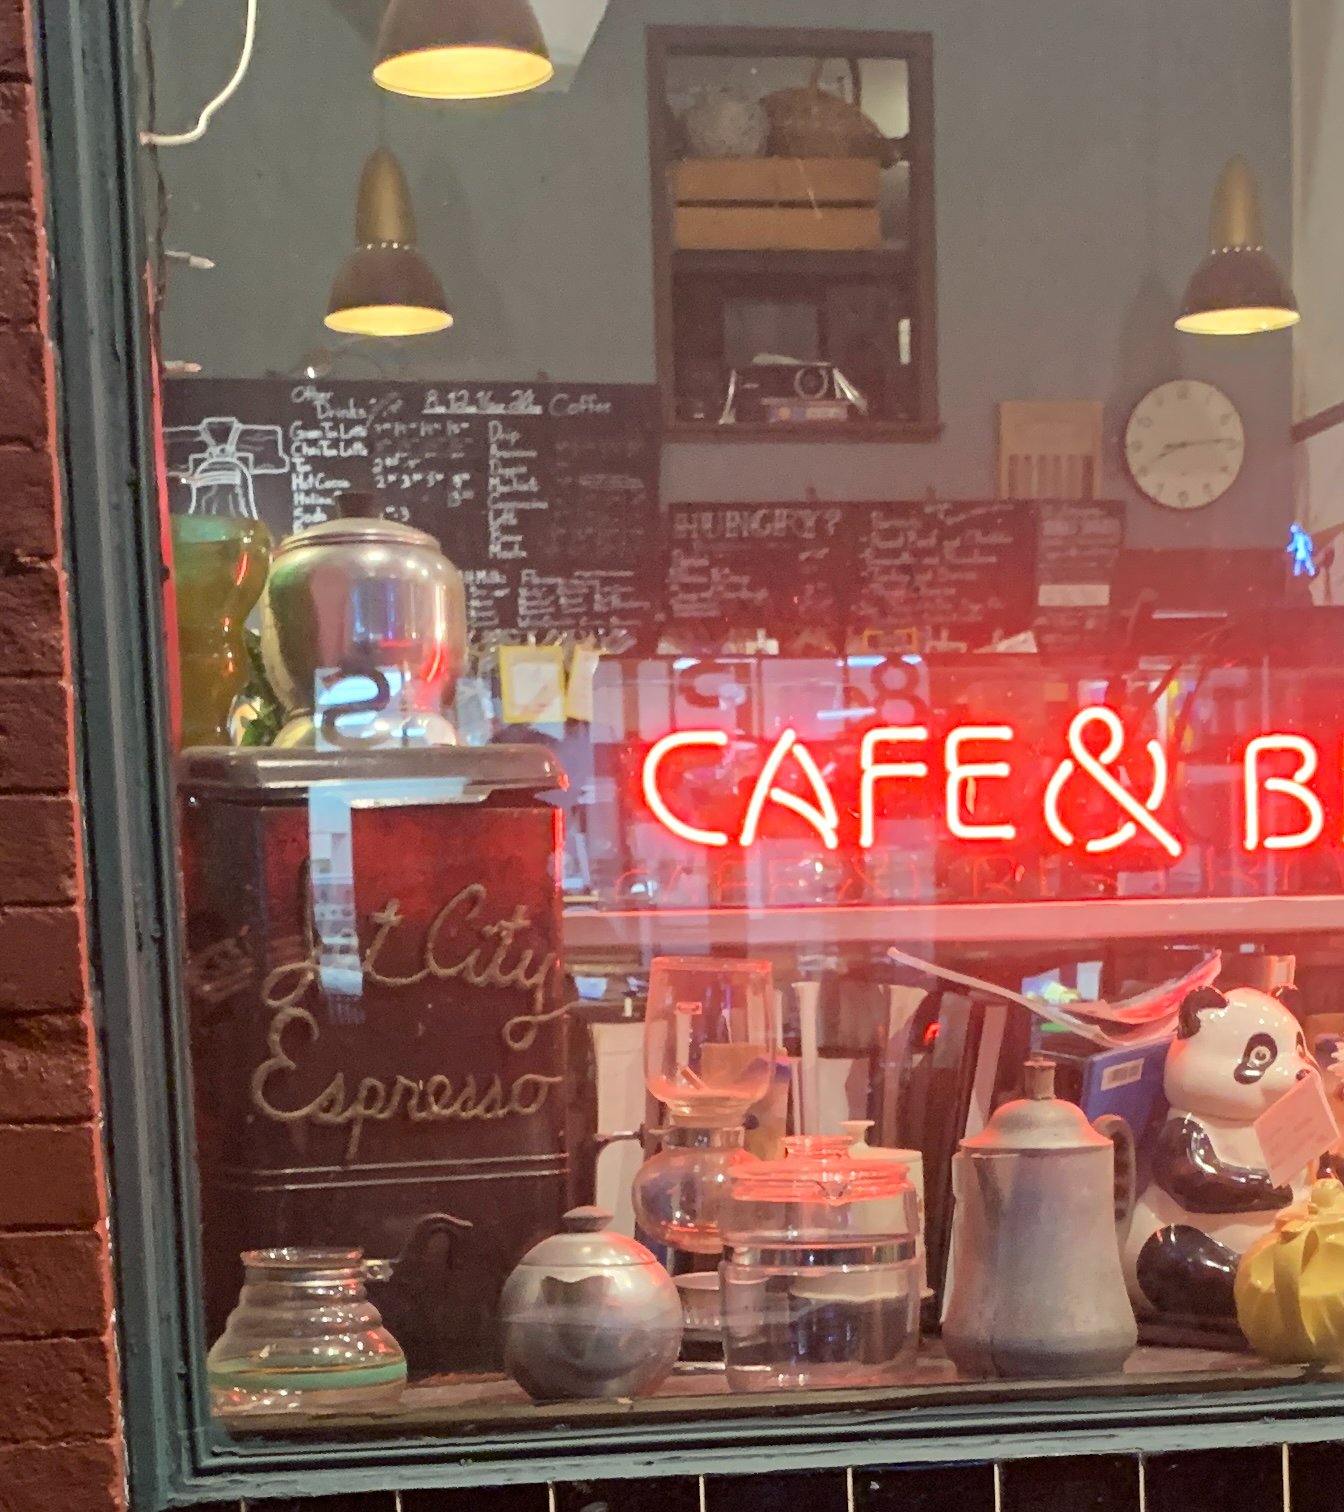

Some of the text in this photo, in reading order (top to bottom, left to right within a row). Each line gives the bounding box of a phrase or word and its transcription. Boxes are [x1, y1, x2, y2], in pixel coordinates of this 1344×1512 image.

[642, 727, 1017, 849] CAFE
[1043, 703, 1183, 857] &
[424, 883, 574, 1050] City
[252, 1006, 563, 1159] Espresso
